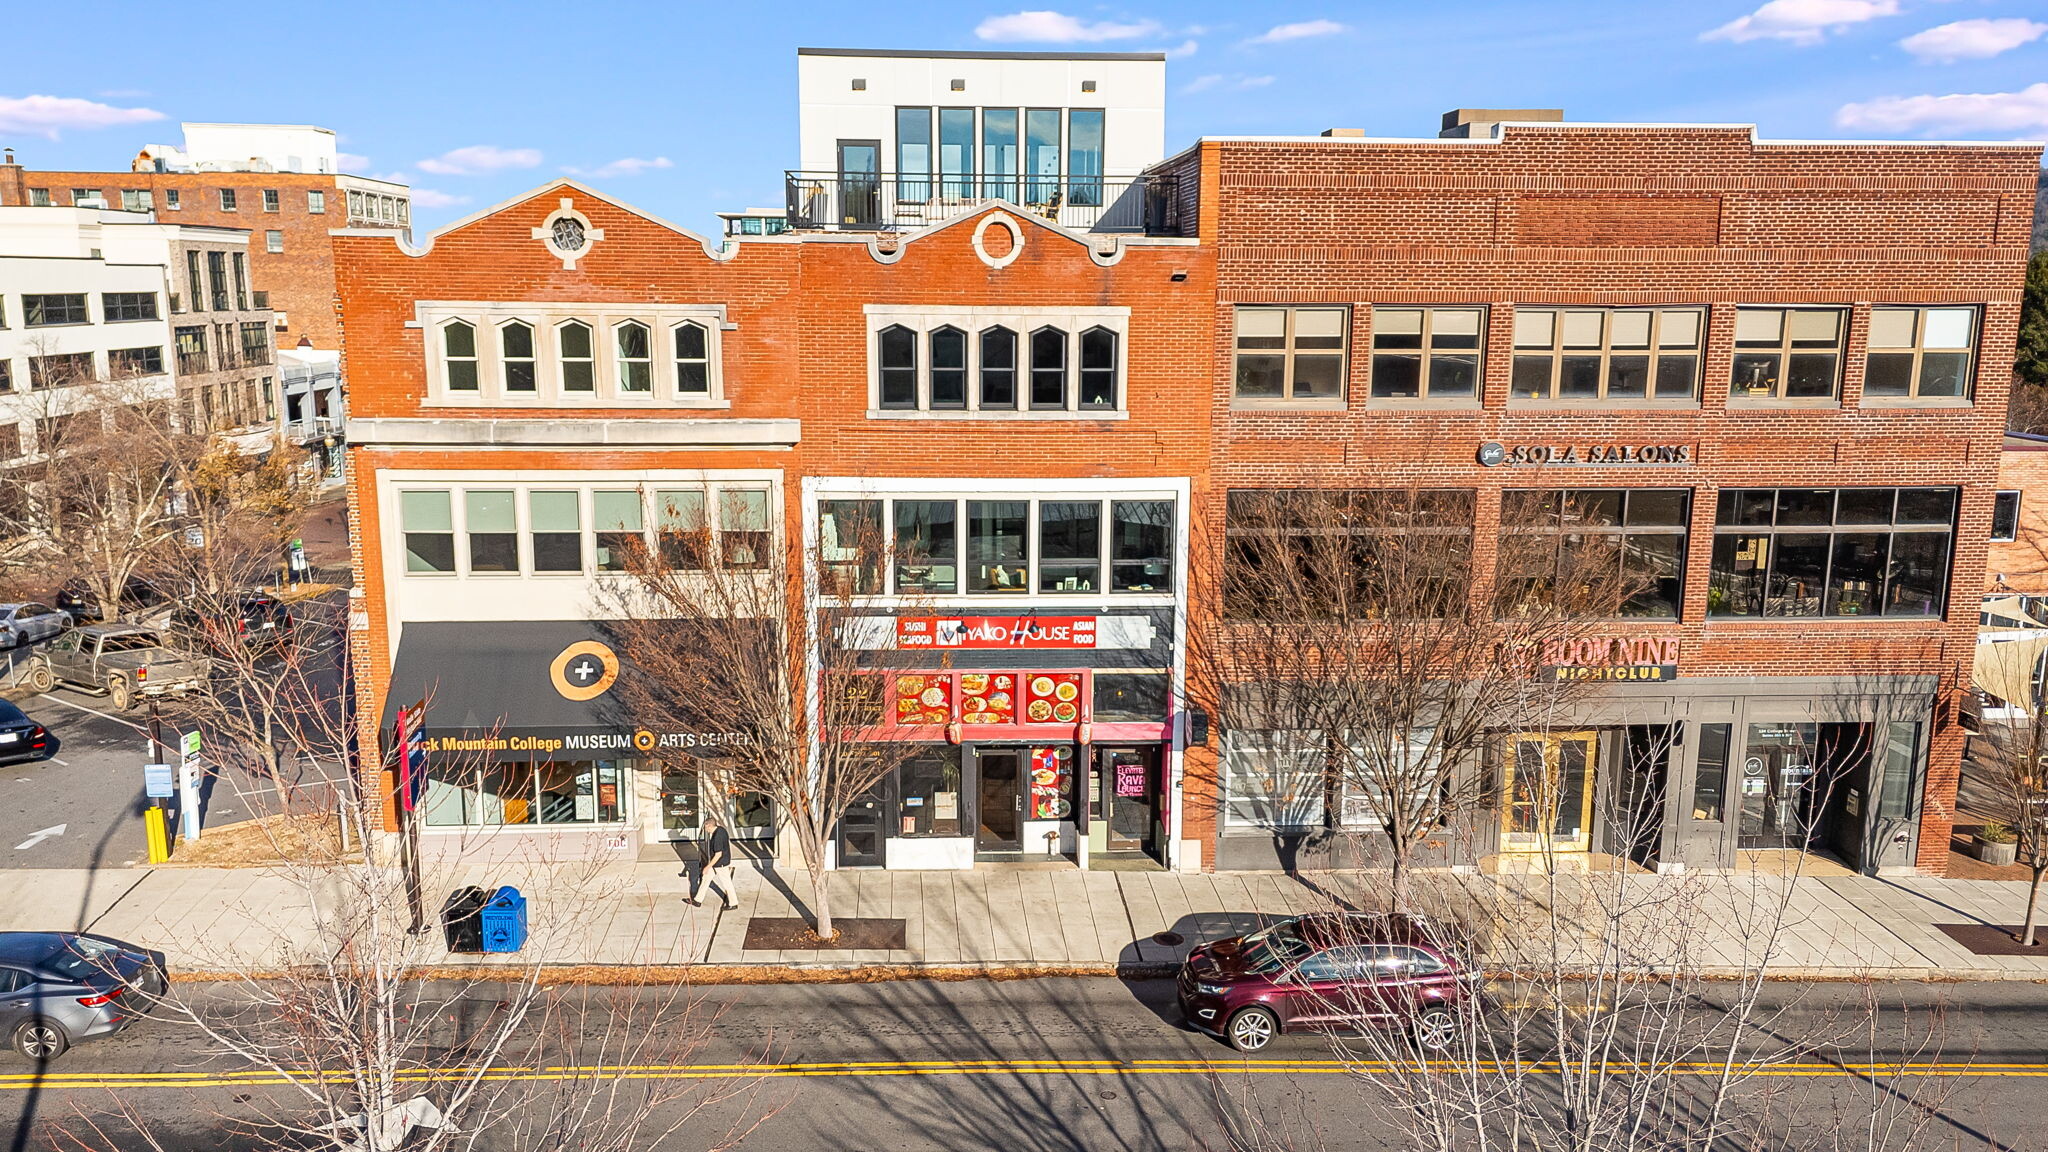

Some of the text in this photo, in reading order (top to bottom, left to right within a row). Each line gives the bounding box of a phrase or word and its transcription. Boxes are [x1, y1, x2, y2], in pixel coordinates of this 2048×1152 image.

[1514, 445, 1690, 463] SOLA SALONS
[904, 621, 927, 632] SUSHI
[1010, 620, 1070, 645] HOUSE
[1073, 621, 1095, 631] ASIAN
[1073, 633, 1095, 644] FOOD
[1541, 637, 1680, 666] ROOM NINE
[1556, 667, 1662, 680] NIGHTCLUB
[442, 737, 507, 751] Mountain
[510, 736, 561, 752] College
[565, 734, 631, 749] MUSEUM
[659, 733, 696, 747] ARTS
